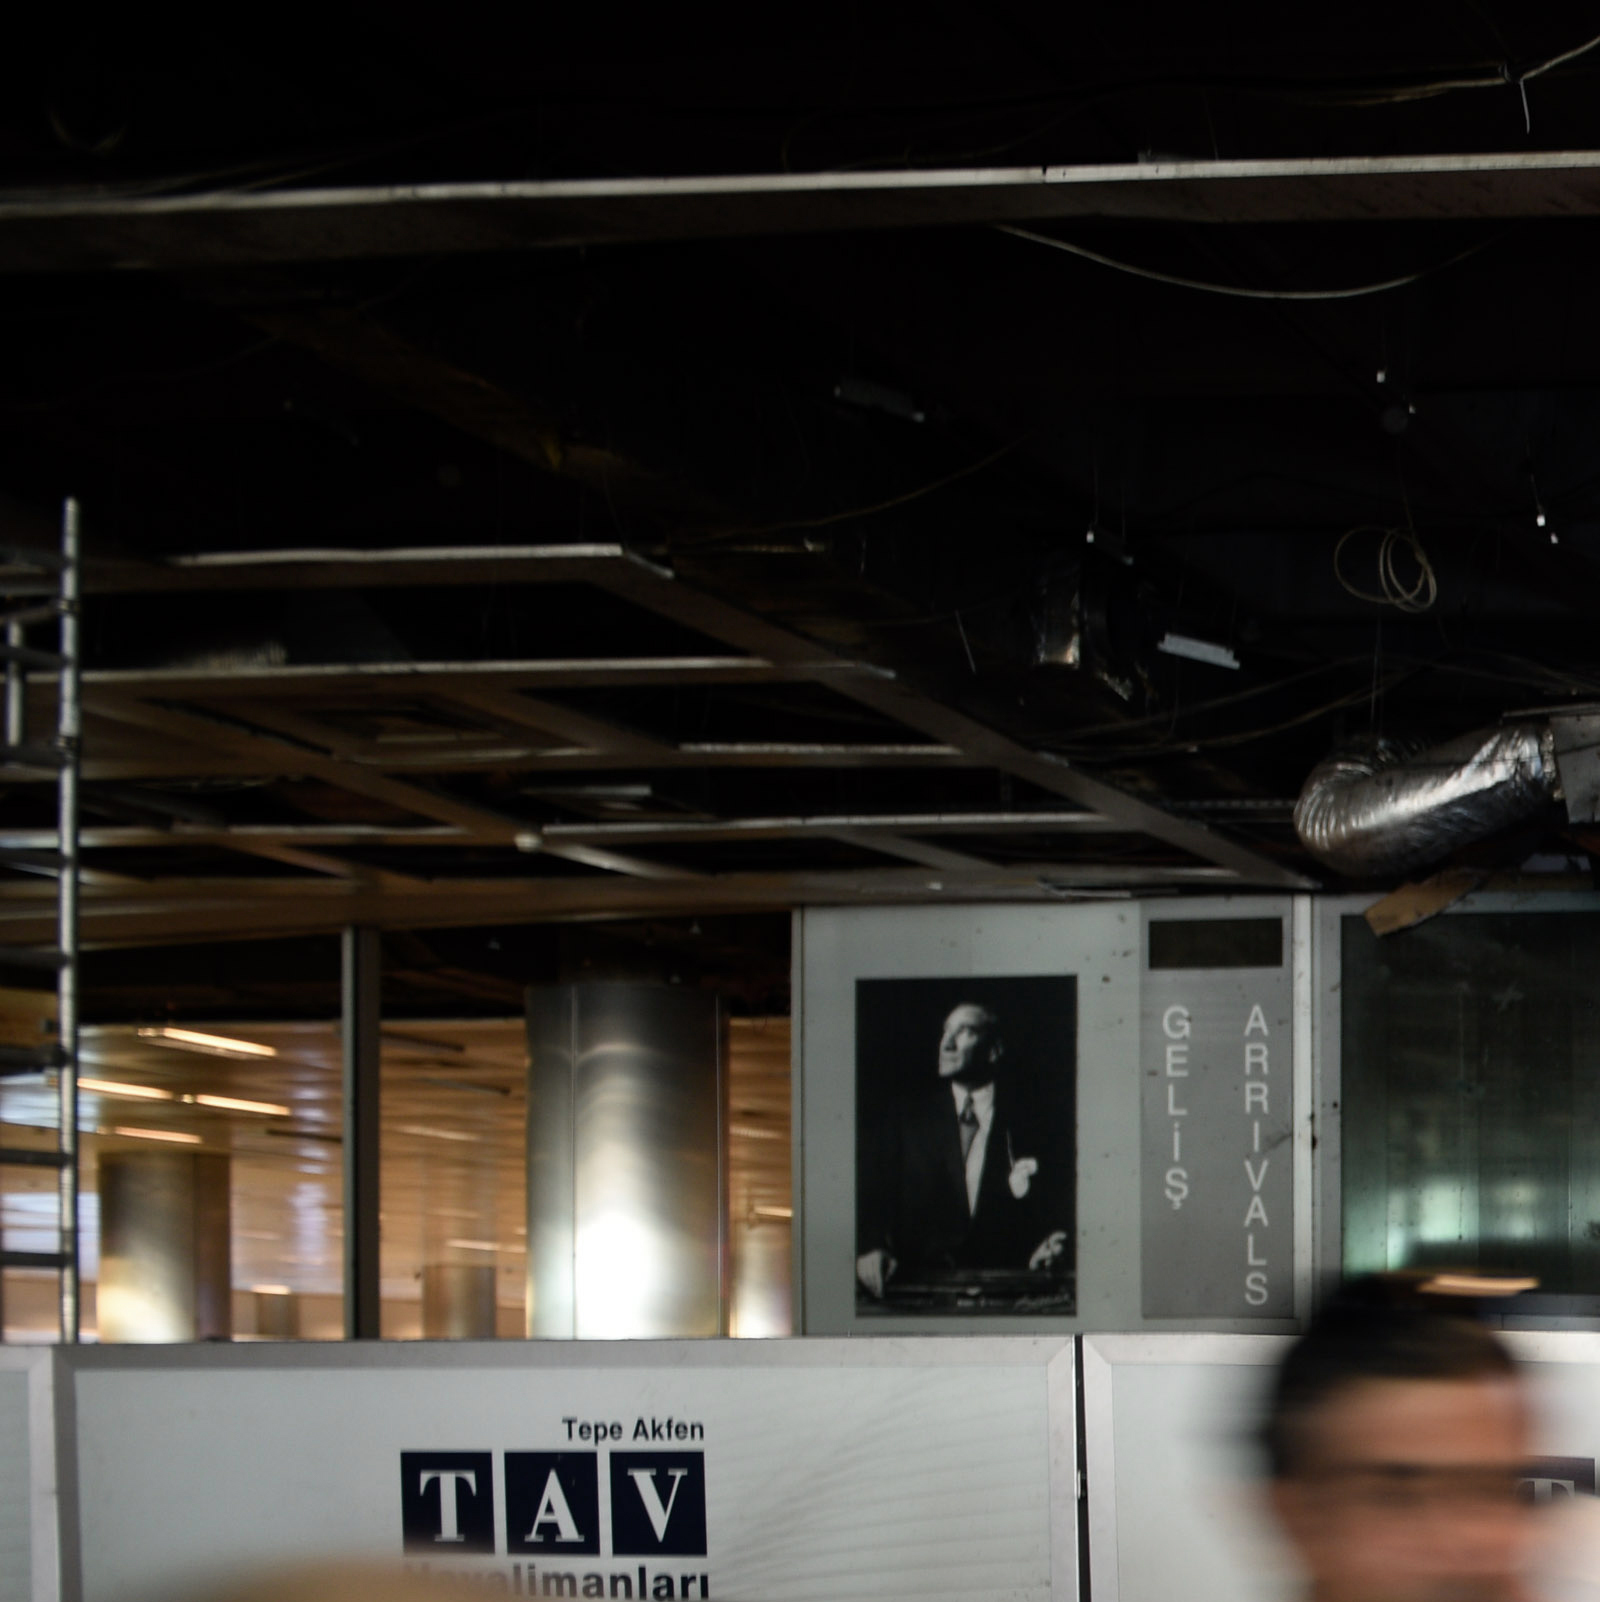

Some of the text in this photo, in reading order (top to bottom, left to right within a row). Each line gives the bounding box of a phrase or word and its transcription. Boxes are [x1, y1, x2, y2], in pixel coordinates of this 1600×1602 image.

[1243, 1003, 1270, 1306] ARRIVALS
[562, 1417, 705, 1445] Tepe Akfen
[418, 1468, 689, 1543] TAV
